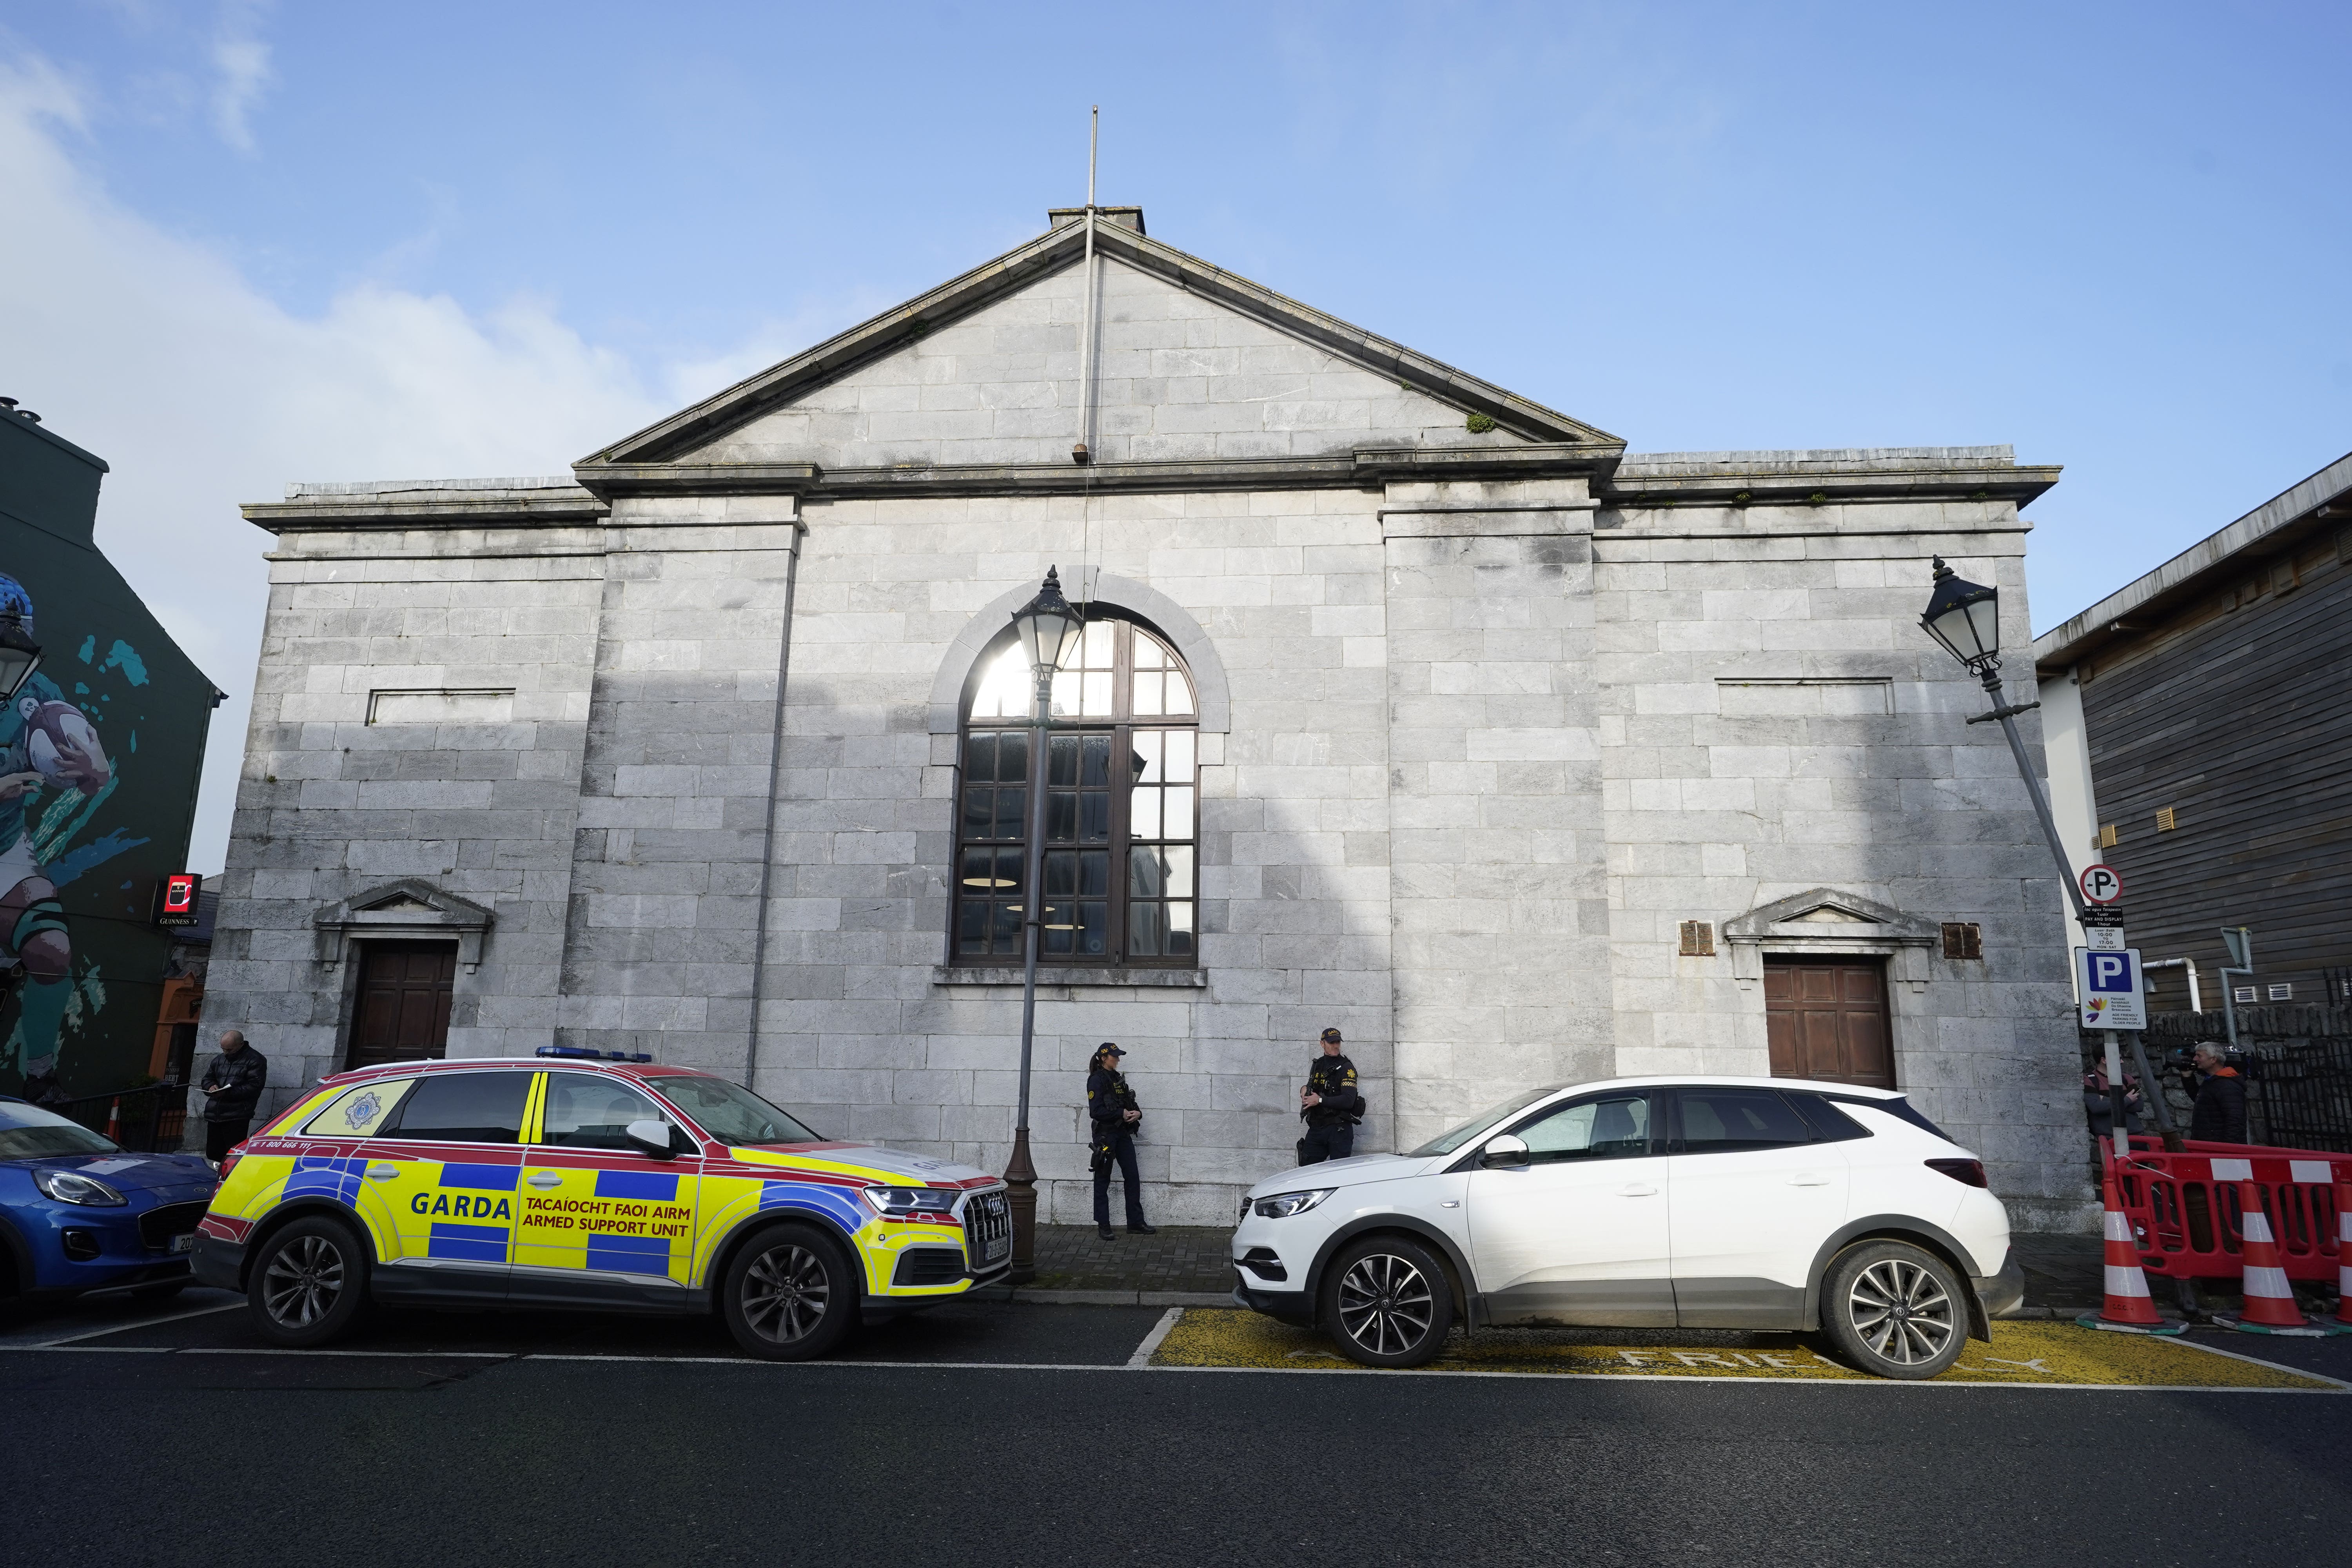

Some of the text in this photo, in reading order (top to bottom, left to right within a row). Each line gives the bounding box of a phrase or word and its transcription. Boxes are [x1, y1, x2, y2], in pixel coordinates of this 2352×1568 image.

[2094, 871, 2111, 896] P
[2096, 956, 2122, 987] P
[411, 1192, 510, 1220] GARDA
[526, 1196, 690, 1220] TACAÍOCHT FAOI AIRM
[523, 1214, 688, 1237] ARMED SUPPORT UNIT
